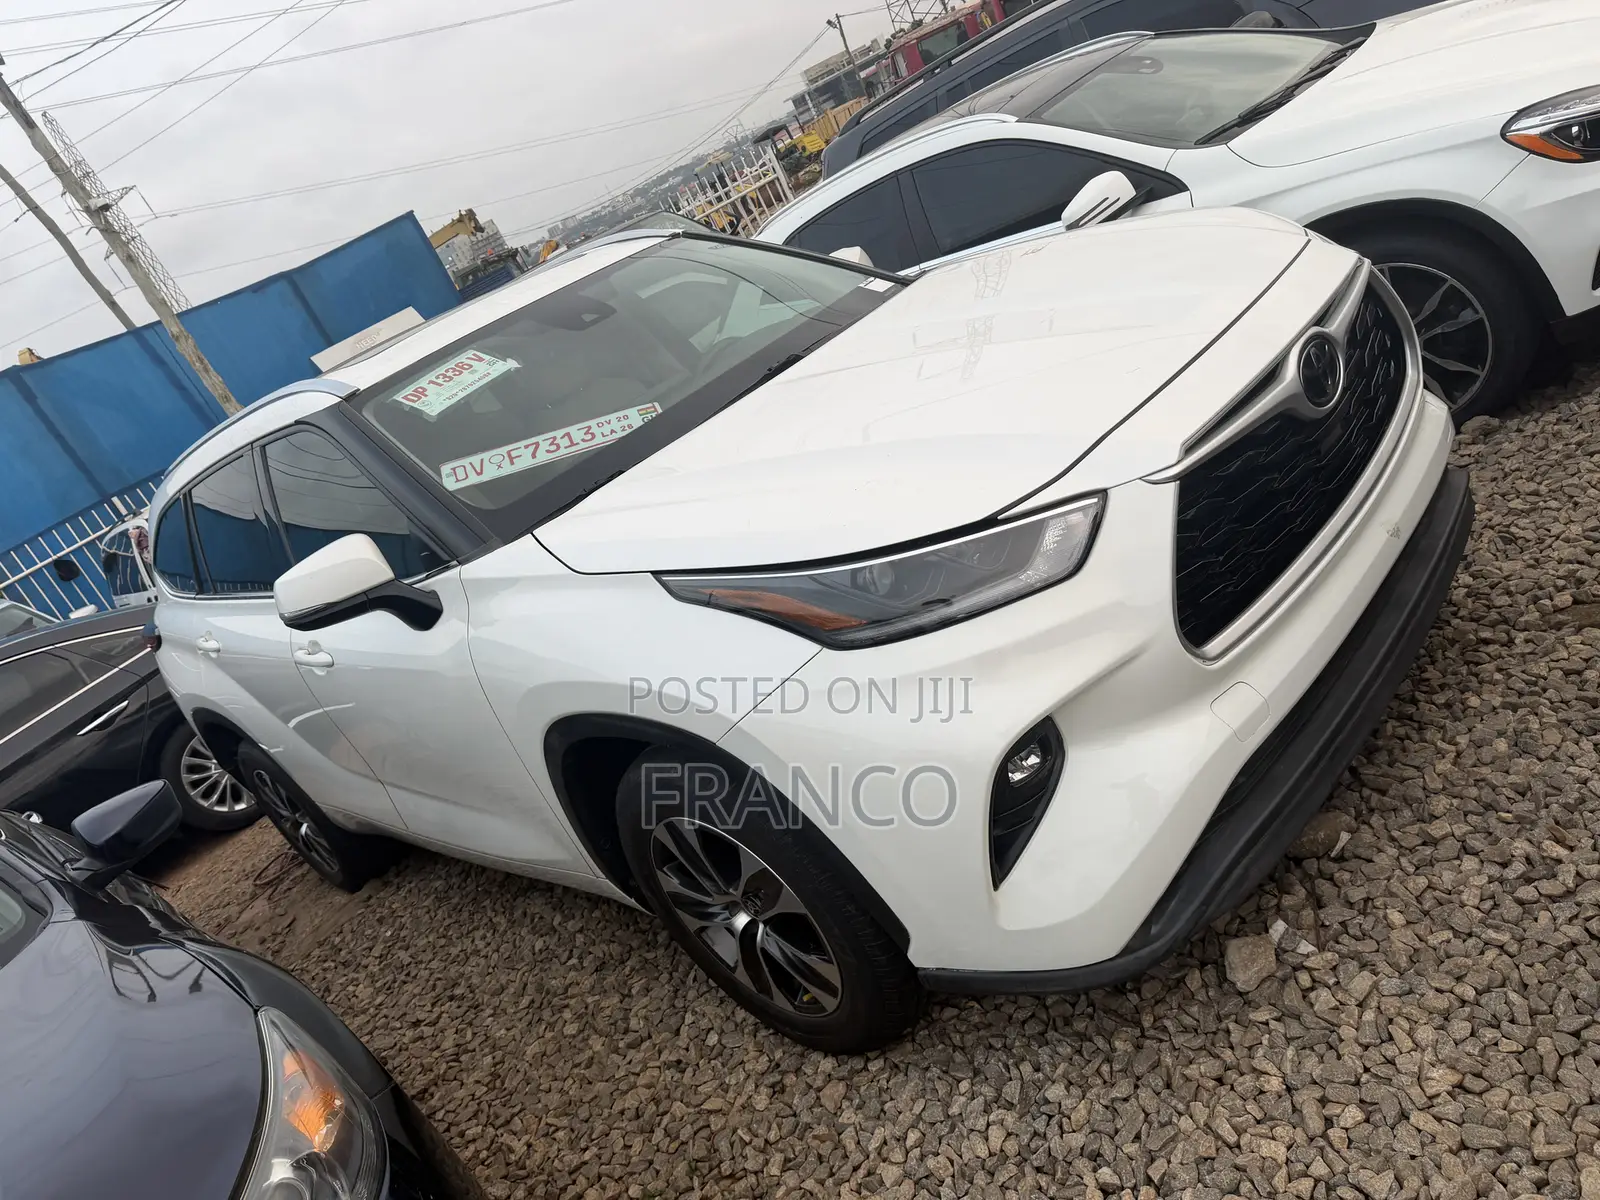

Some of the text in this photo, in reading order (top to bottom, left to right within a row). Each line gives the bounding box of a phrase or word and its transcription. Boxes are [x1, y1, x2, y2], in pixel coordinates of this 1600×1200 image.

[401, 386, 429, 404] DP
[427, 361, 474, 388] 1336
[465, 353, 486, 363] V
[596, 419, 612, 428] DV
[601, 428, 618, 438] LA
[450, 425, 597, 483] DV F7313
